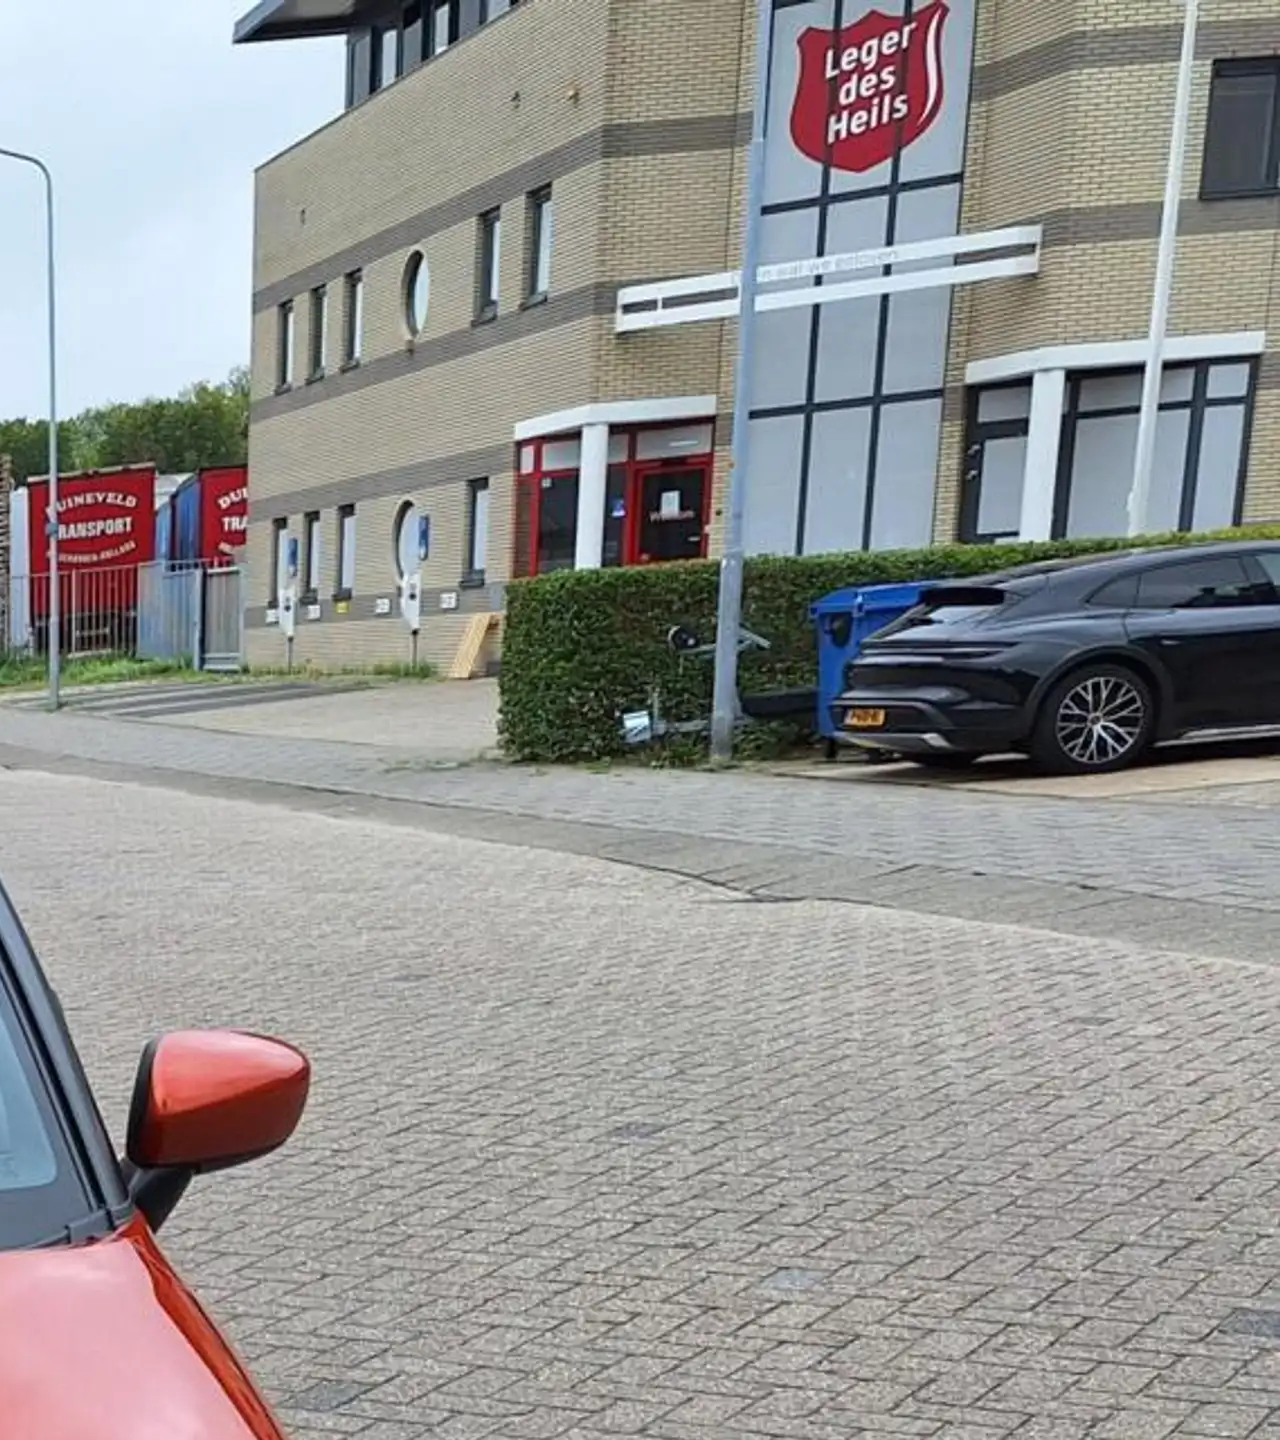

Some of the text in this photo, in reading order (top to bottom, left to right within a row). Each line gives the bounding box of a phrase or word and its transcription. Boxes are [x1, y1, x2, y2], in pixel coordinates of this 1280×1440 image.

[825, 23, 917, 79] Leger
[839, 64, 896, 106] des
[827, 94, 909, 145] Heils
[57, 516, 133, 540] RANSPORT
